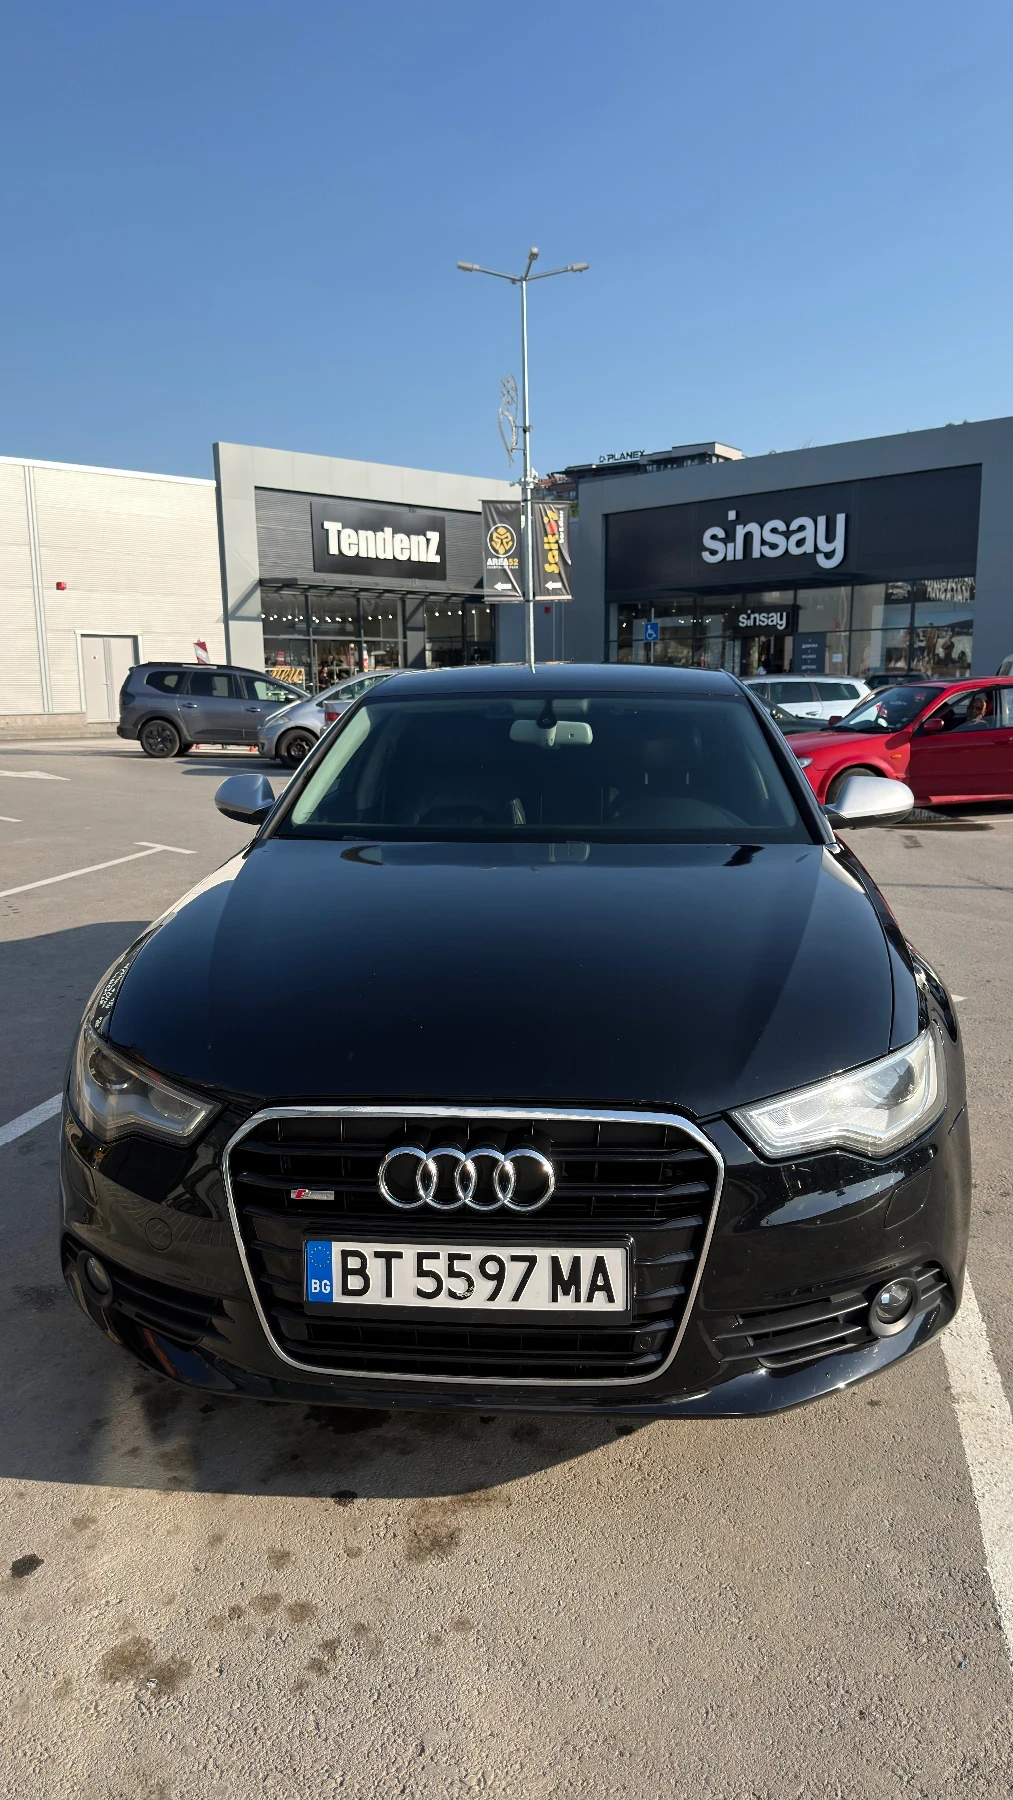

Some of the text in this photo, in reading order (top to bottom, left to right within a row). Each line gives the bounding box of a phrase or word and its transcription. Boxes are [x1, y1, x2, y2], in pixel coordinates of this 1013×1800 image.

[606, 450, 645, 462] PLANEX
[323, 520, 441, 563] TendenZ
[701, 510, 847, 569] sinsay
[738, 610, 787, 630] sinsay
[311, 1279, 331, 1294] BG
[341, 1249, 616, 1303] BT 5597 MA
